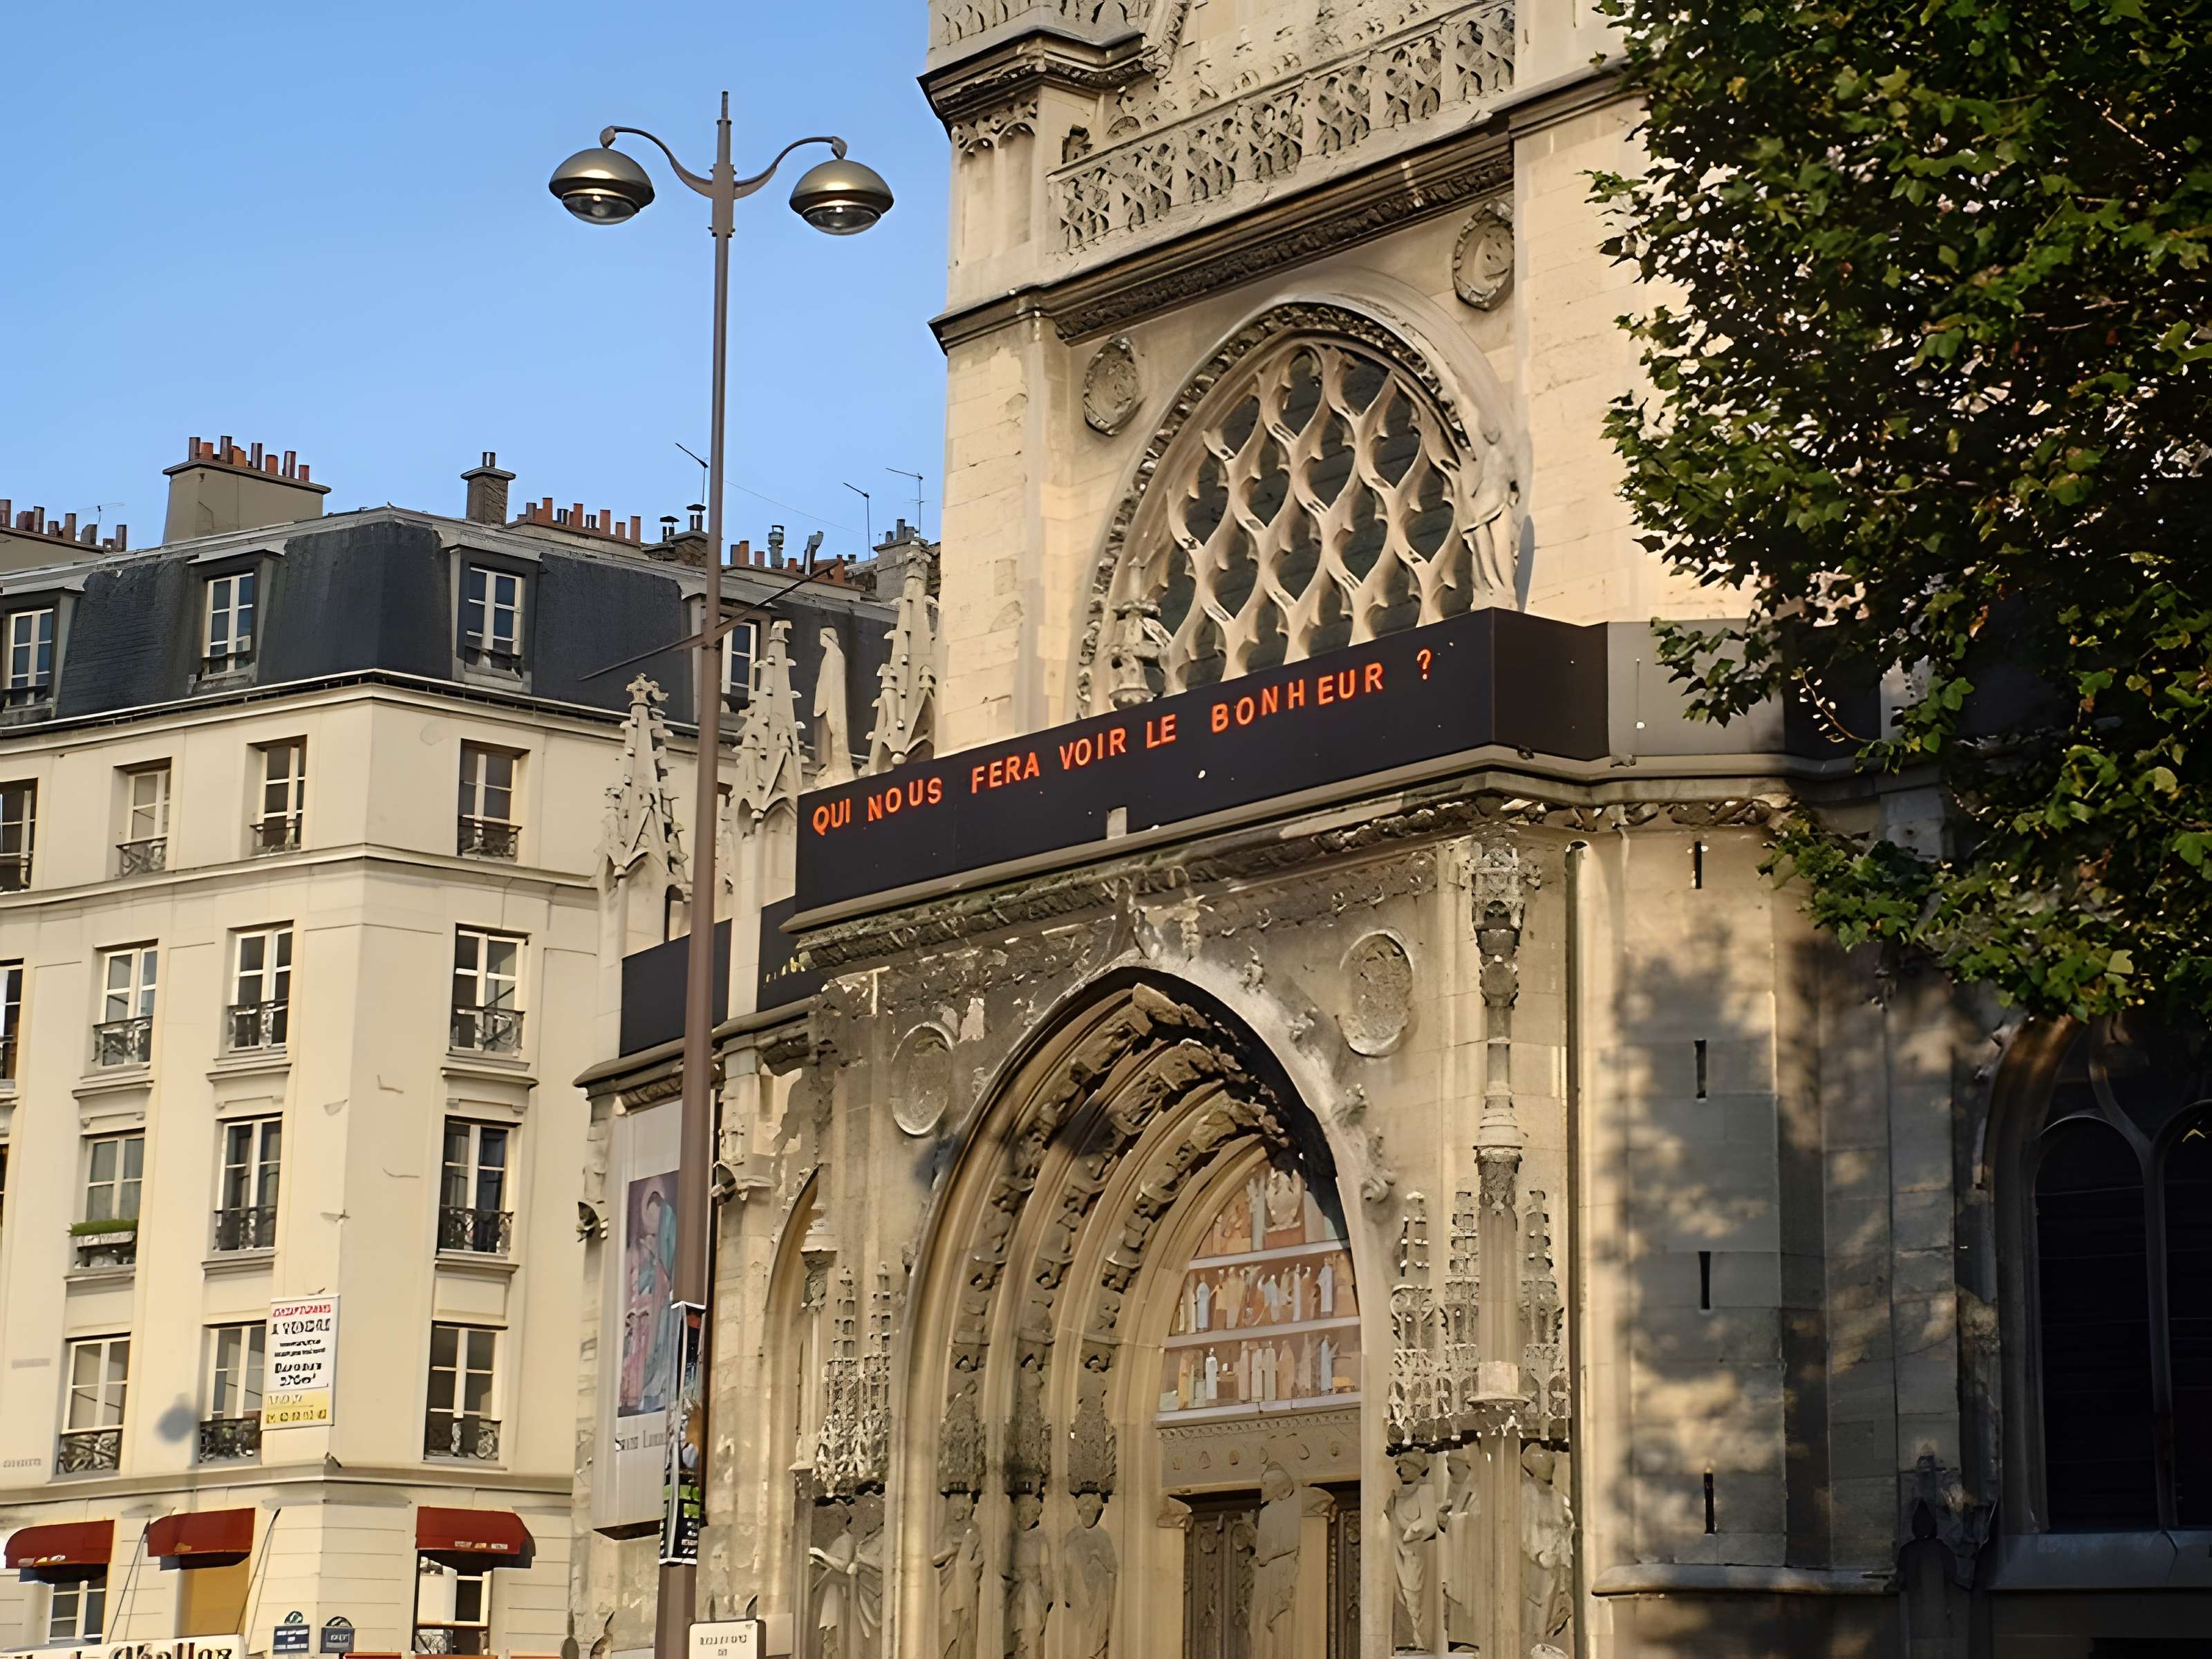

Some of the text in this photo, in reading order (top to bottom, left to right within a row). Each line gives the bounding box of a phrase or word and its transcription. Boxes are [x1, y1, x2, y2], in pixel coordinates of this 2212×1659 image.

[812, 648, 1432, 836] QUI NOUS FERA VOIR LE BONHEUR ?
